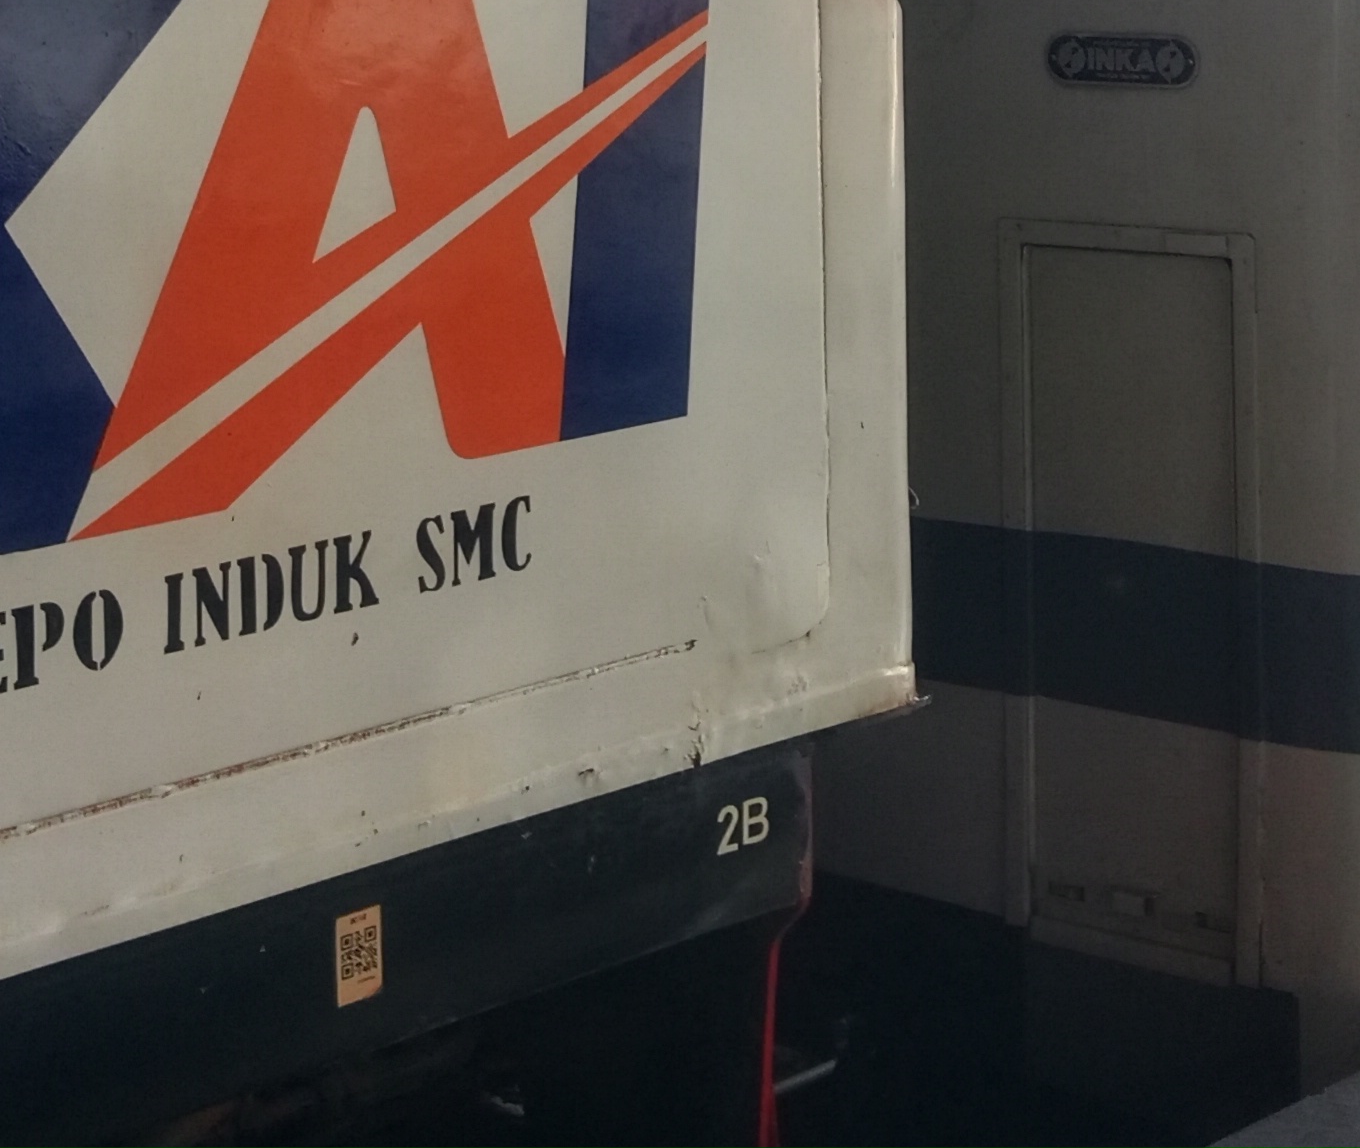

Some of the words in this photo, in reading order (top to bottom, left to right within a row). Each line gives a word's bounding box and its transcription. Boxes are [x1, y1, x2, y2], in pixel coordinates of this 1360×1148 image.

[1087, 46, 1157, 73] INKA
[163, 529, 379, 654] INDUK
[416, 495, 533, 595] SMC
[716, 795, 771, 857] 2B
